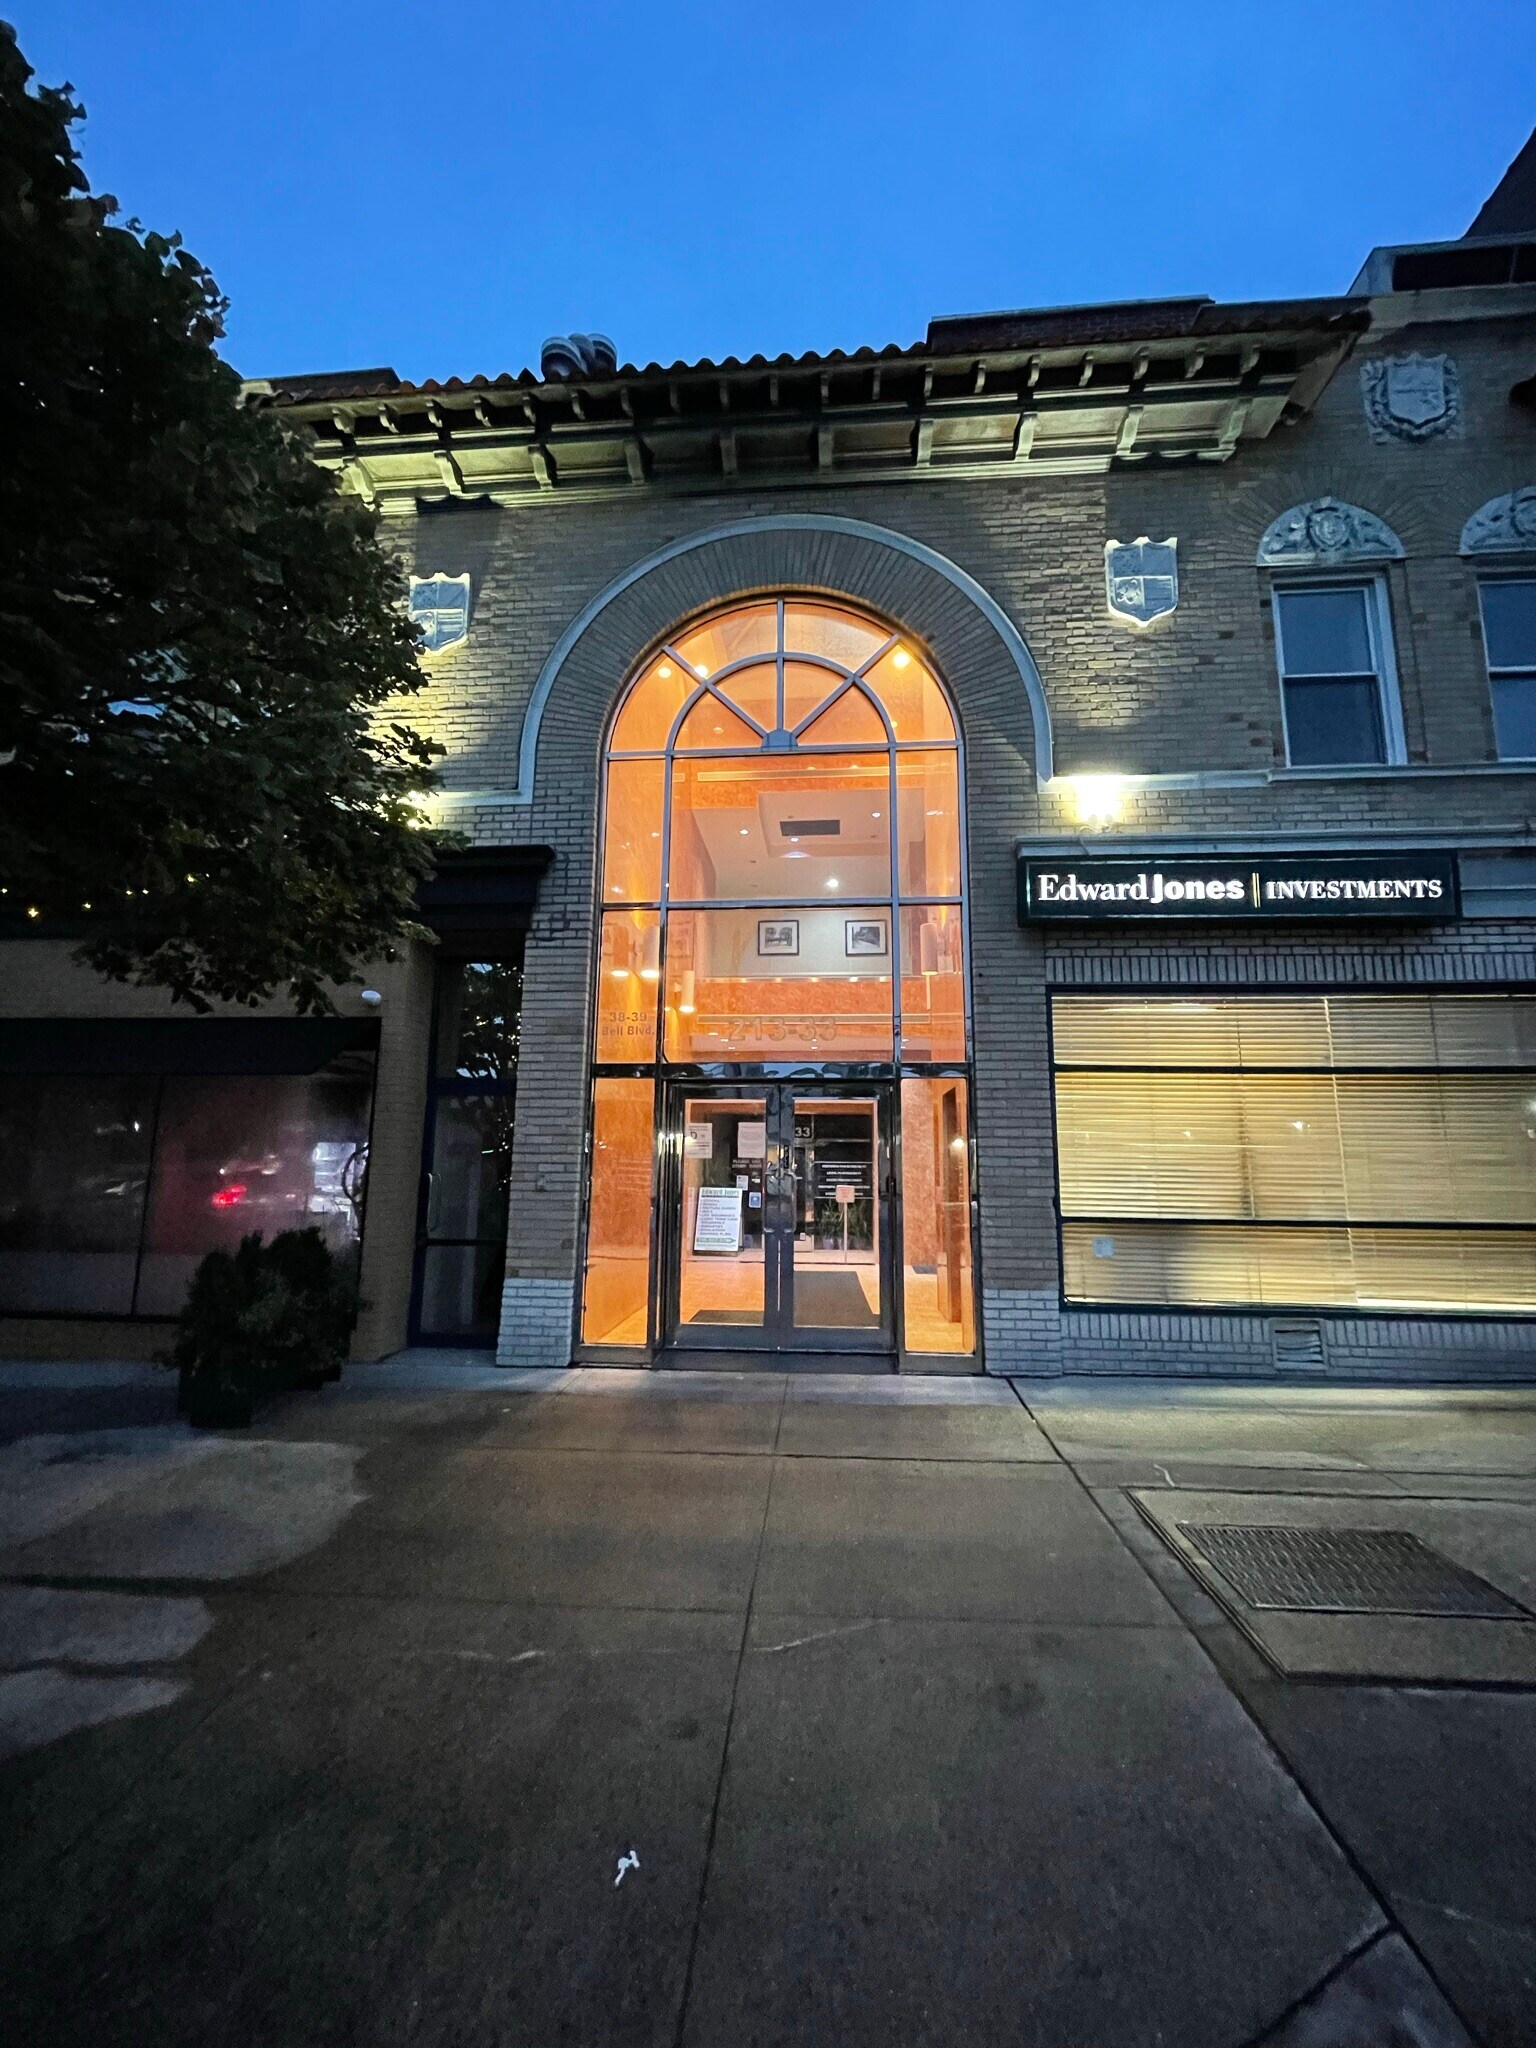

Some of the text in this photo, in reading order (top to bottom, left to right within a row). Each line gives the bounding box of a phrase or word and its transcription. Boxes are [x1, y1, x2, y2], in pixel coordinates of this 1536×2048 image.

[1037, 873, 1444, 904] Edward Jones INVESTMENTS
[609, 1011, 648, 1022] 38-39
[602, 1025, 655, 1036] Bell Blvd.
[729, 1015, 838, 1042] 213-33
